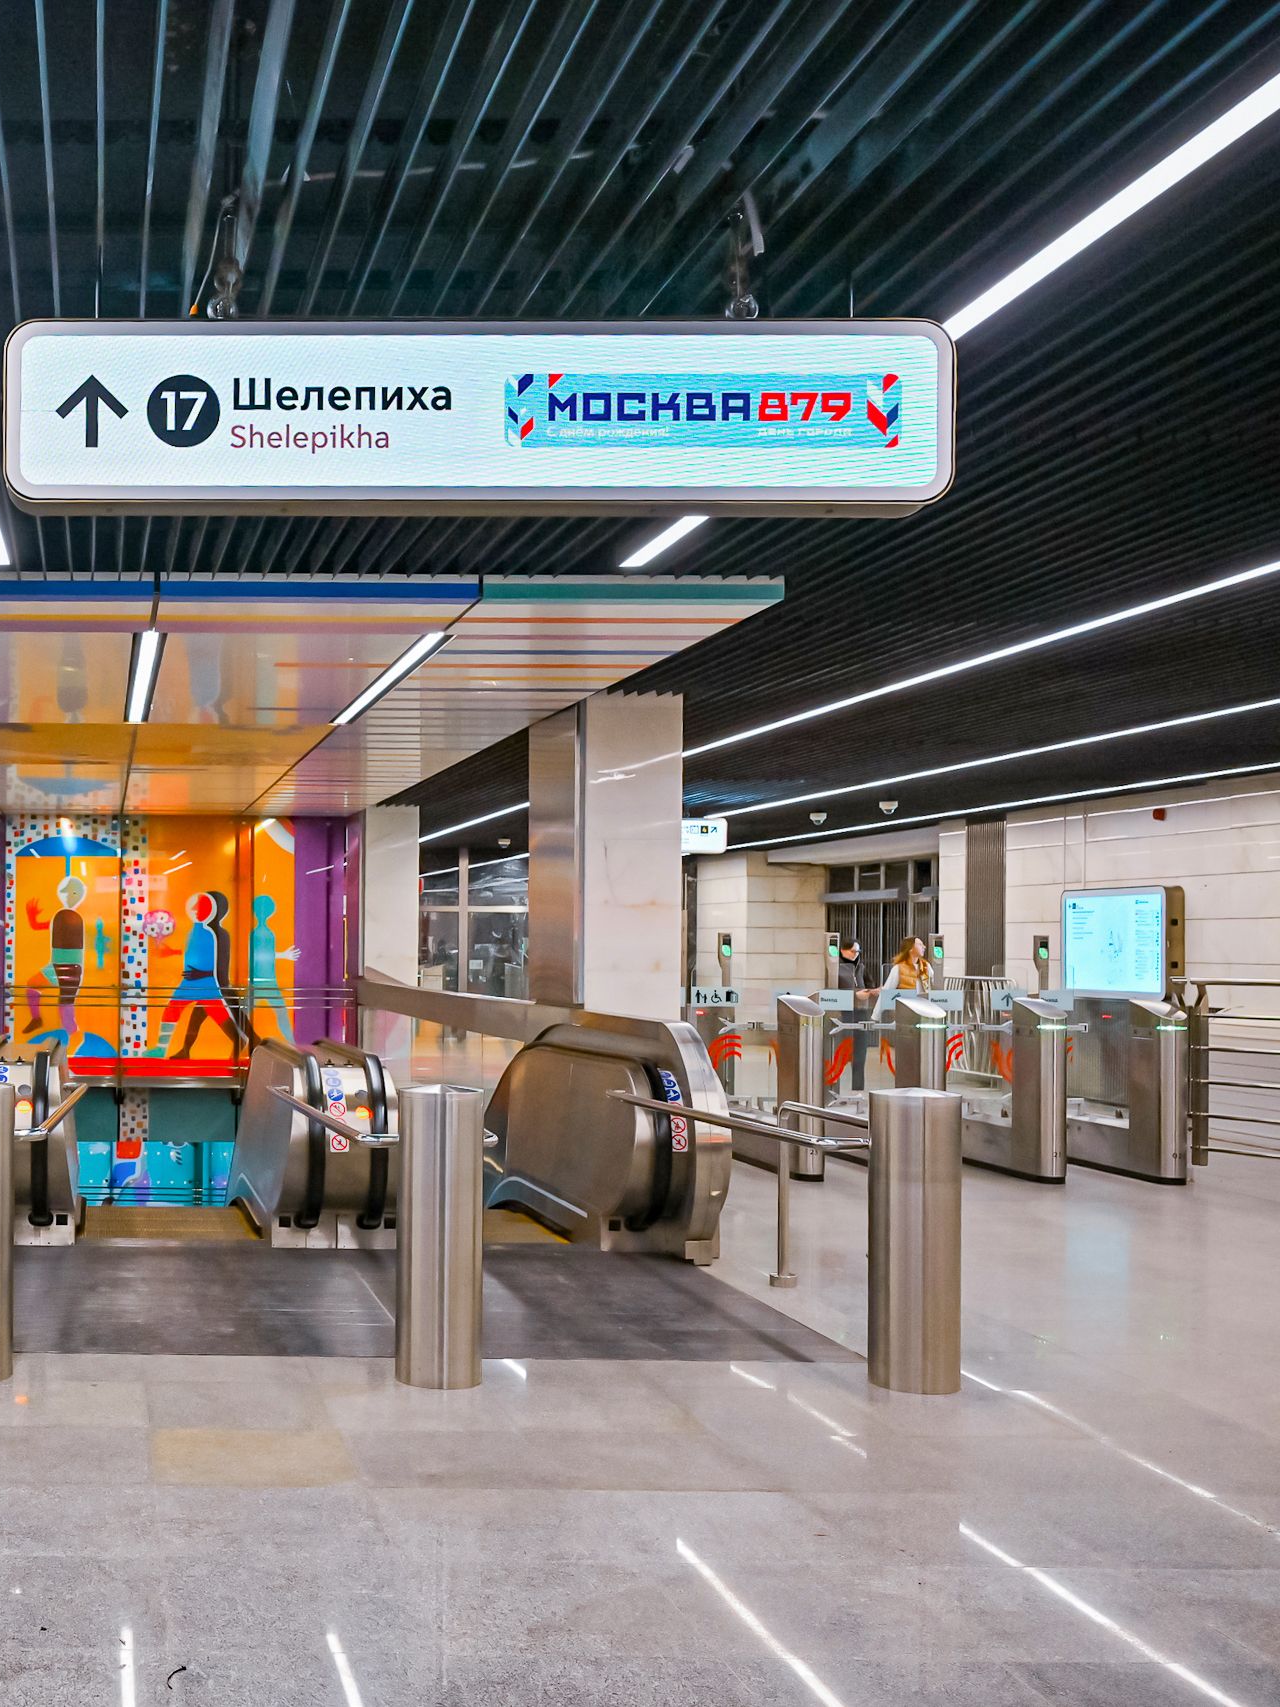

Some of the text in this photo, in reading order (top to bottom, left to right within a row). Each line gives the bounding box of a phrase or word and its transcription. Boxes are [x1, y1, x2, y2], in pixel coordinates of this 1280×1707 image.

[160, 377, 452, 431] 17 Шелепиха
[548, 392, 852, 422] МОСКВА 879
[230, 424, 389, 454] Shelepikha
